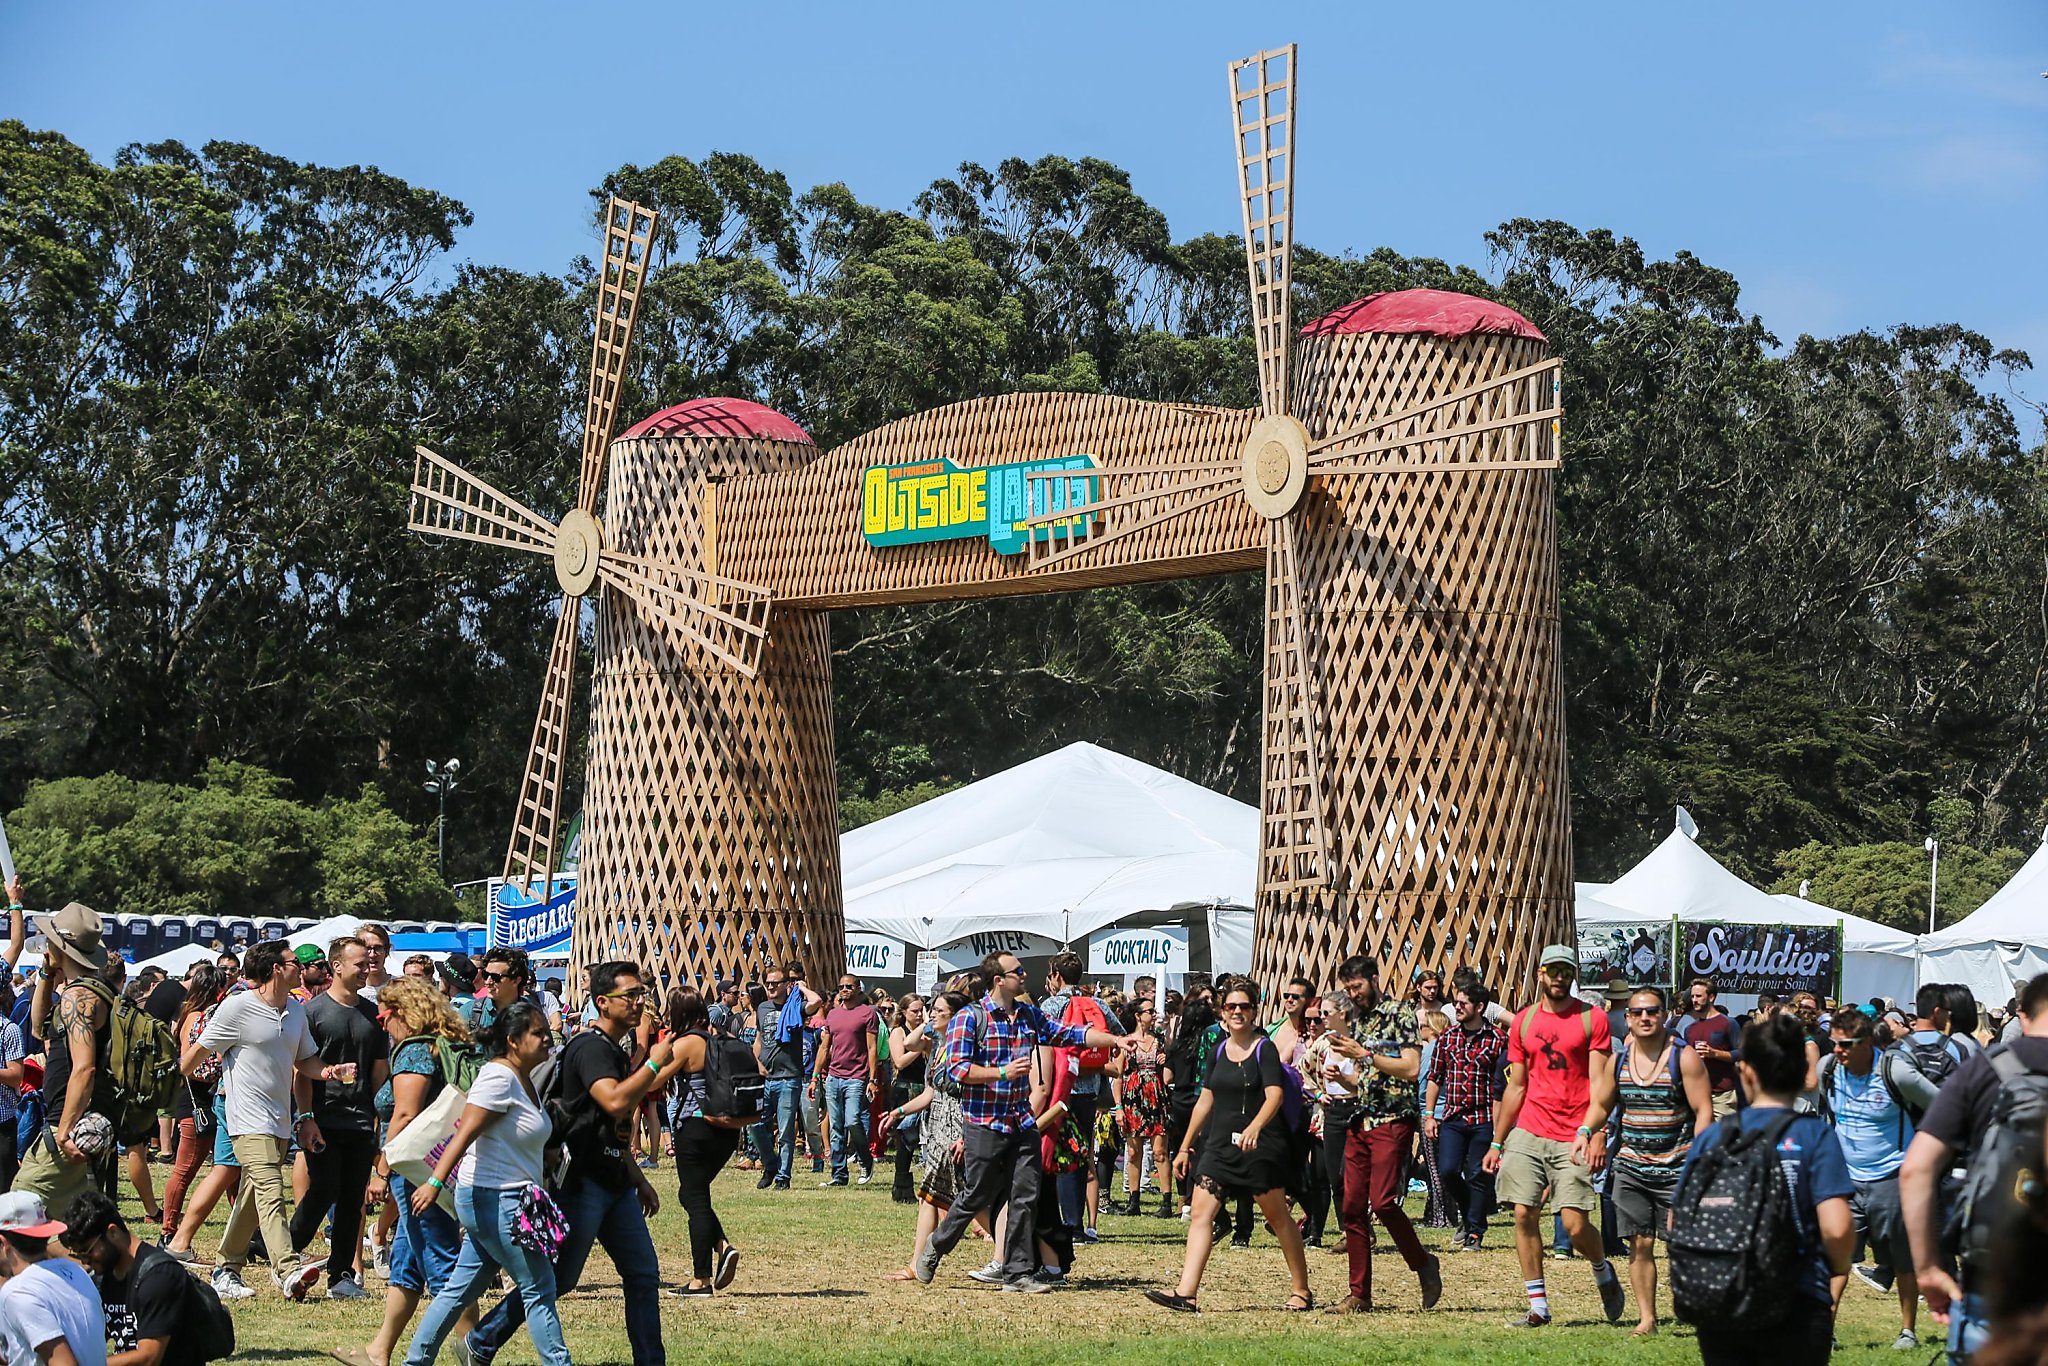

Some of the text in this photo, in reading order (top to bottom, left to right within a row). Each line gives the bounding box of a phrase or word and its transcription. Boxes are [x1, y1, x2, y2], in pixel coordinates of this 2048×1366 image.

[864, 459, 1085, 542] OUTSIDE LANDS
[1053, 514, 1082, 528] FESTAL
[970, 931, 1030, 957] WATER
[1104, 939, 1172, 965] COCKTAILS
[1689, 927, 1830, 976] Souldier
[1738, 975, 1757, 991] for
[1758, 980, 1783, 991] your
[1784, 976, 1809, 990] Soul
